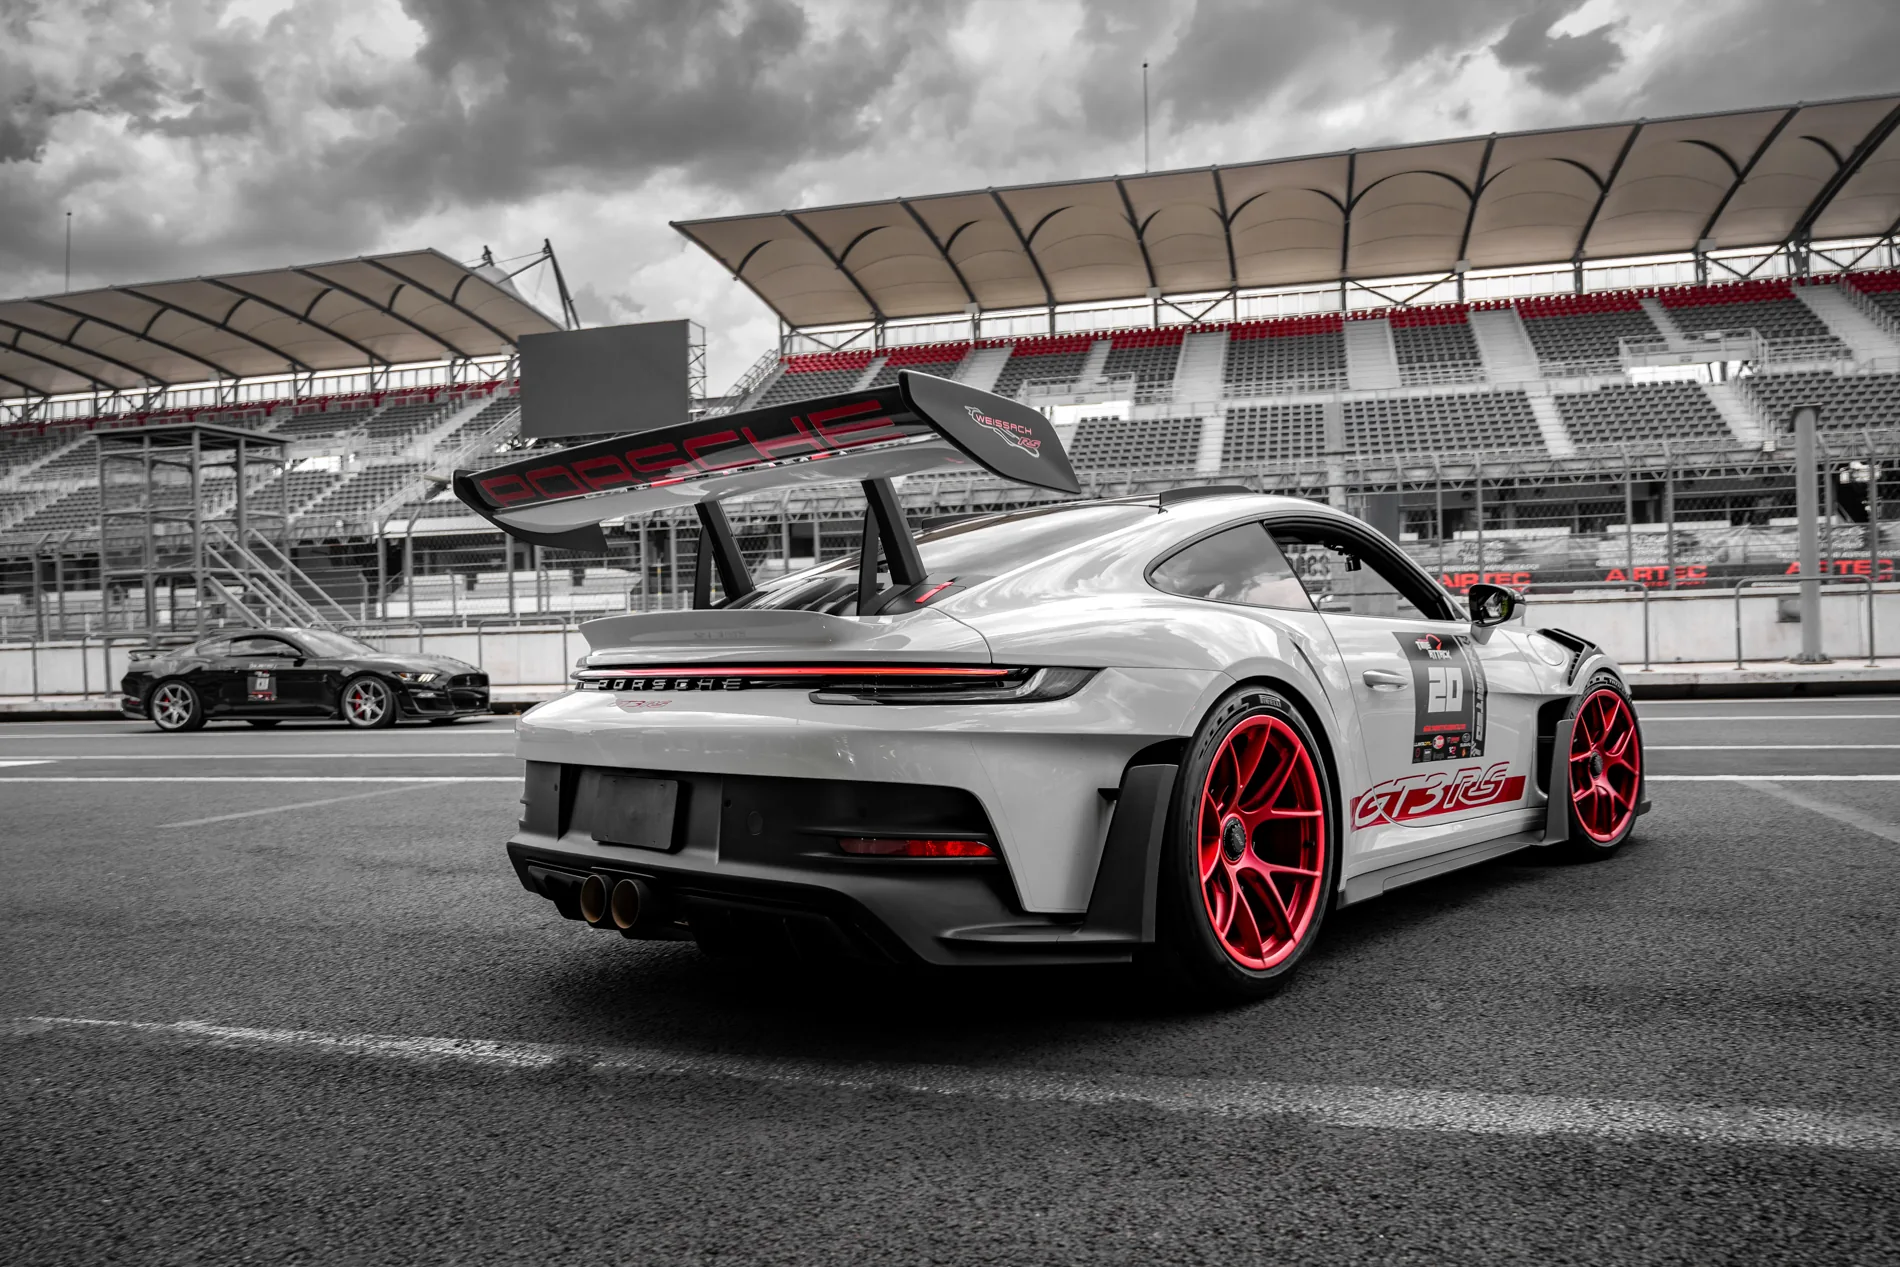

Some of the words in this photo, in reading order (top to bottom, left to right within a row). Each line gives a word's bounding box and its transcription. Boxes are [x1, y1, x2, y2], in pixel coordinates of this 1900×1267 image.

[975, 413, 1032, 436] WEISSACH
[480, 400, 908, 507] PORSCHE
[1605, 565, 1708, 582] ARTEC
[1785, 558, 1894, 575] ATEC
[598, 679, 742, 691] PORSCHE
[1427, 667, 1463, 713] 20
